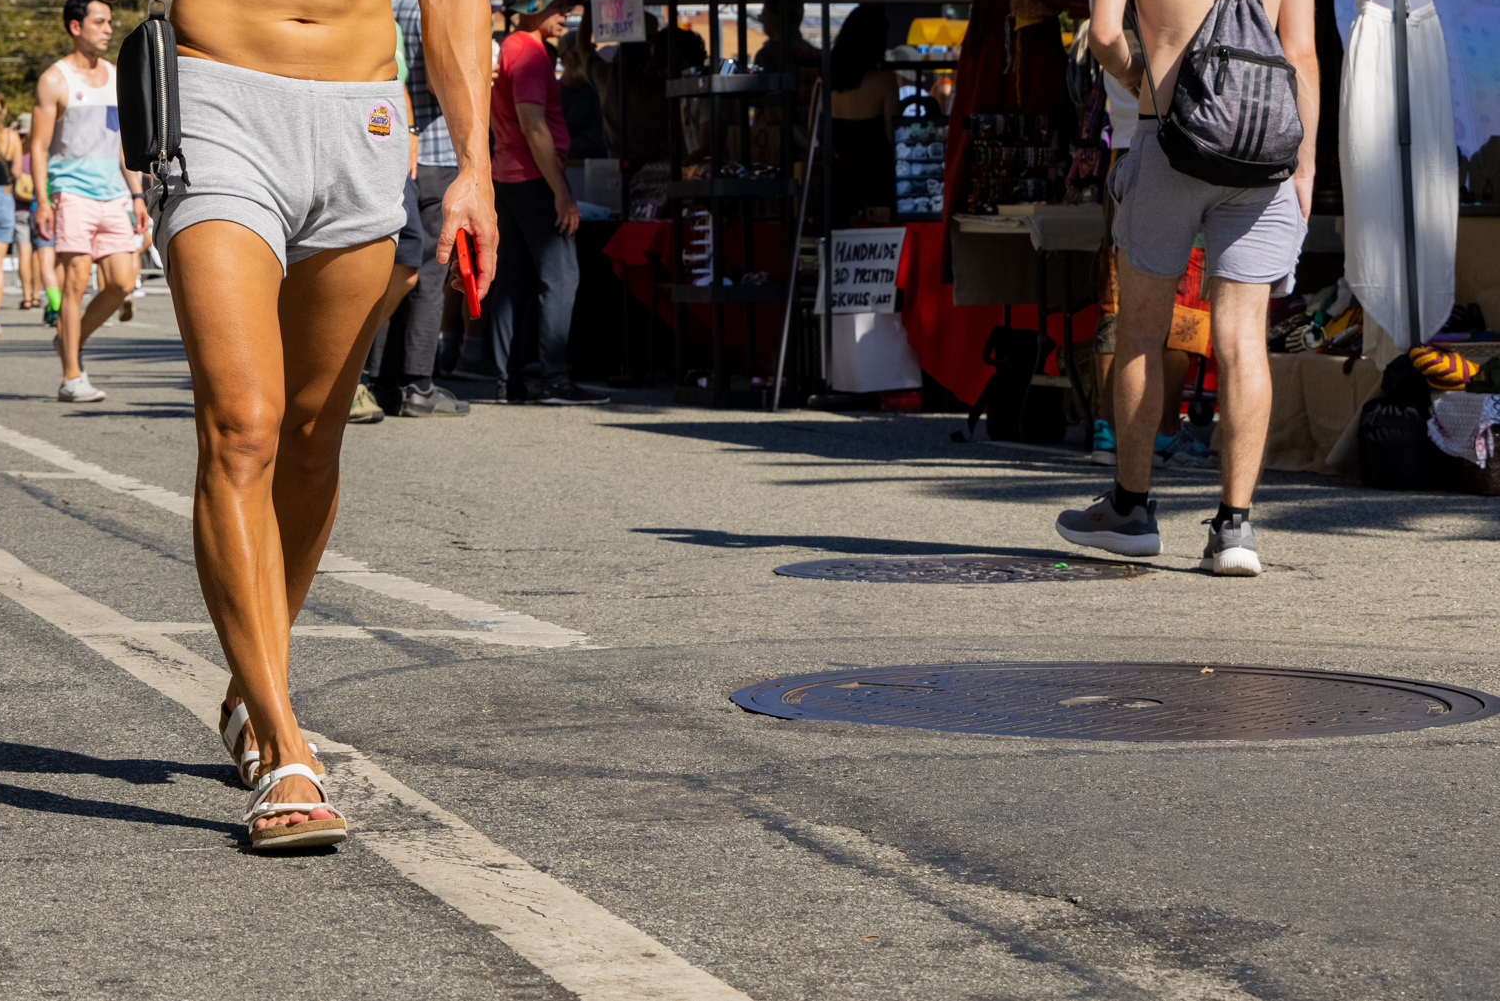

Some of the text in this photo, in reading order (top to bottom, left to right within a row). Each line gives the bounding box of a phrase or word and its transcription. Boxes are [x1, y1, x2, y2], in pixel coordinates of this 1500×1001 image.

[834, 241, 898, 262] HANDMADE
[833, 267, 895, 285] 3D PRINTED
[876, 294, 892, 305] ART
